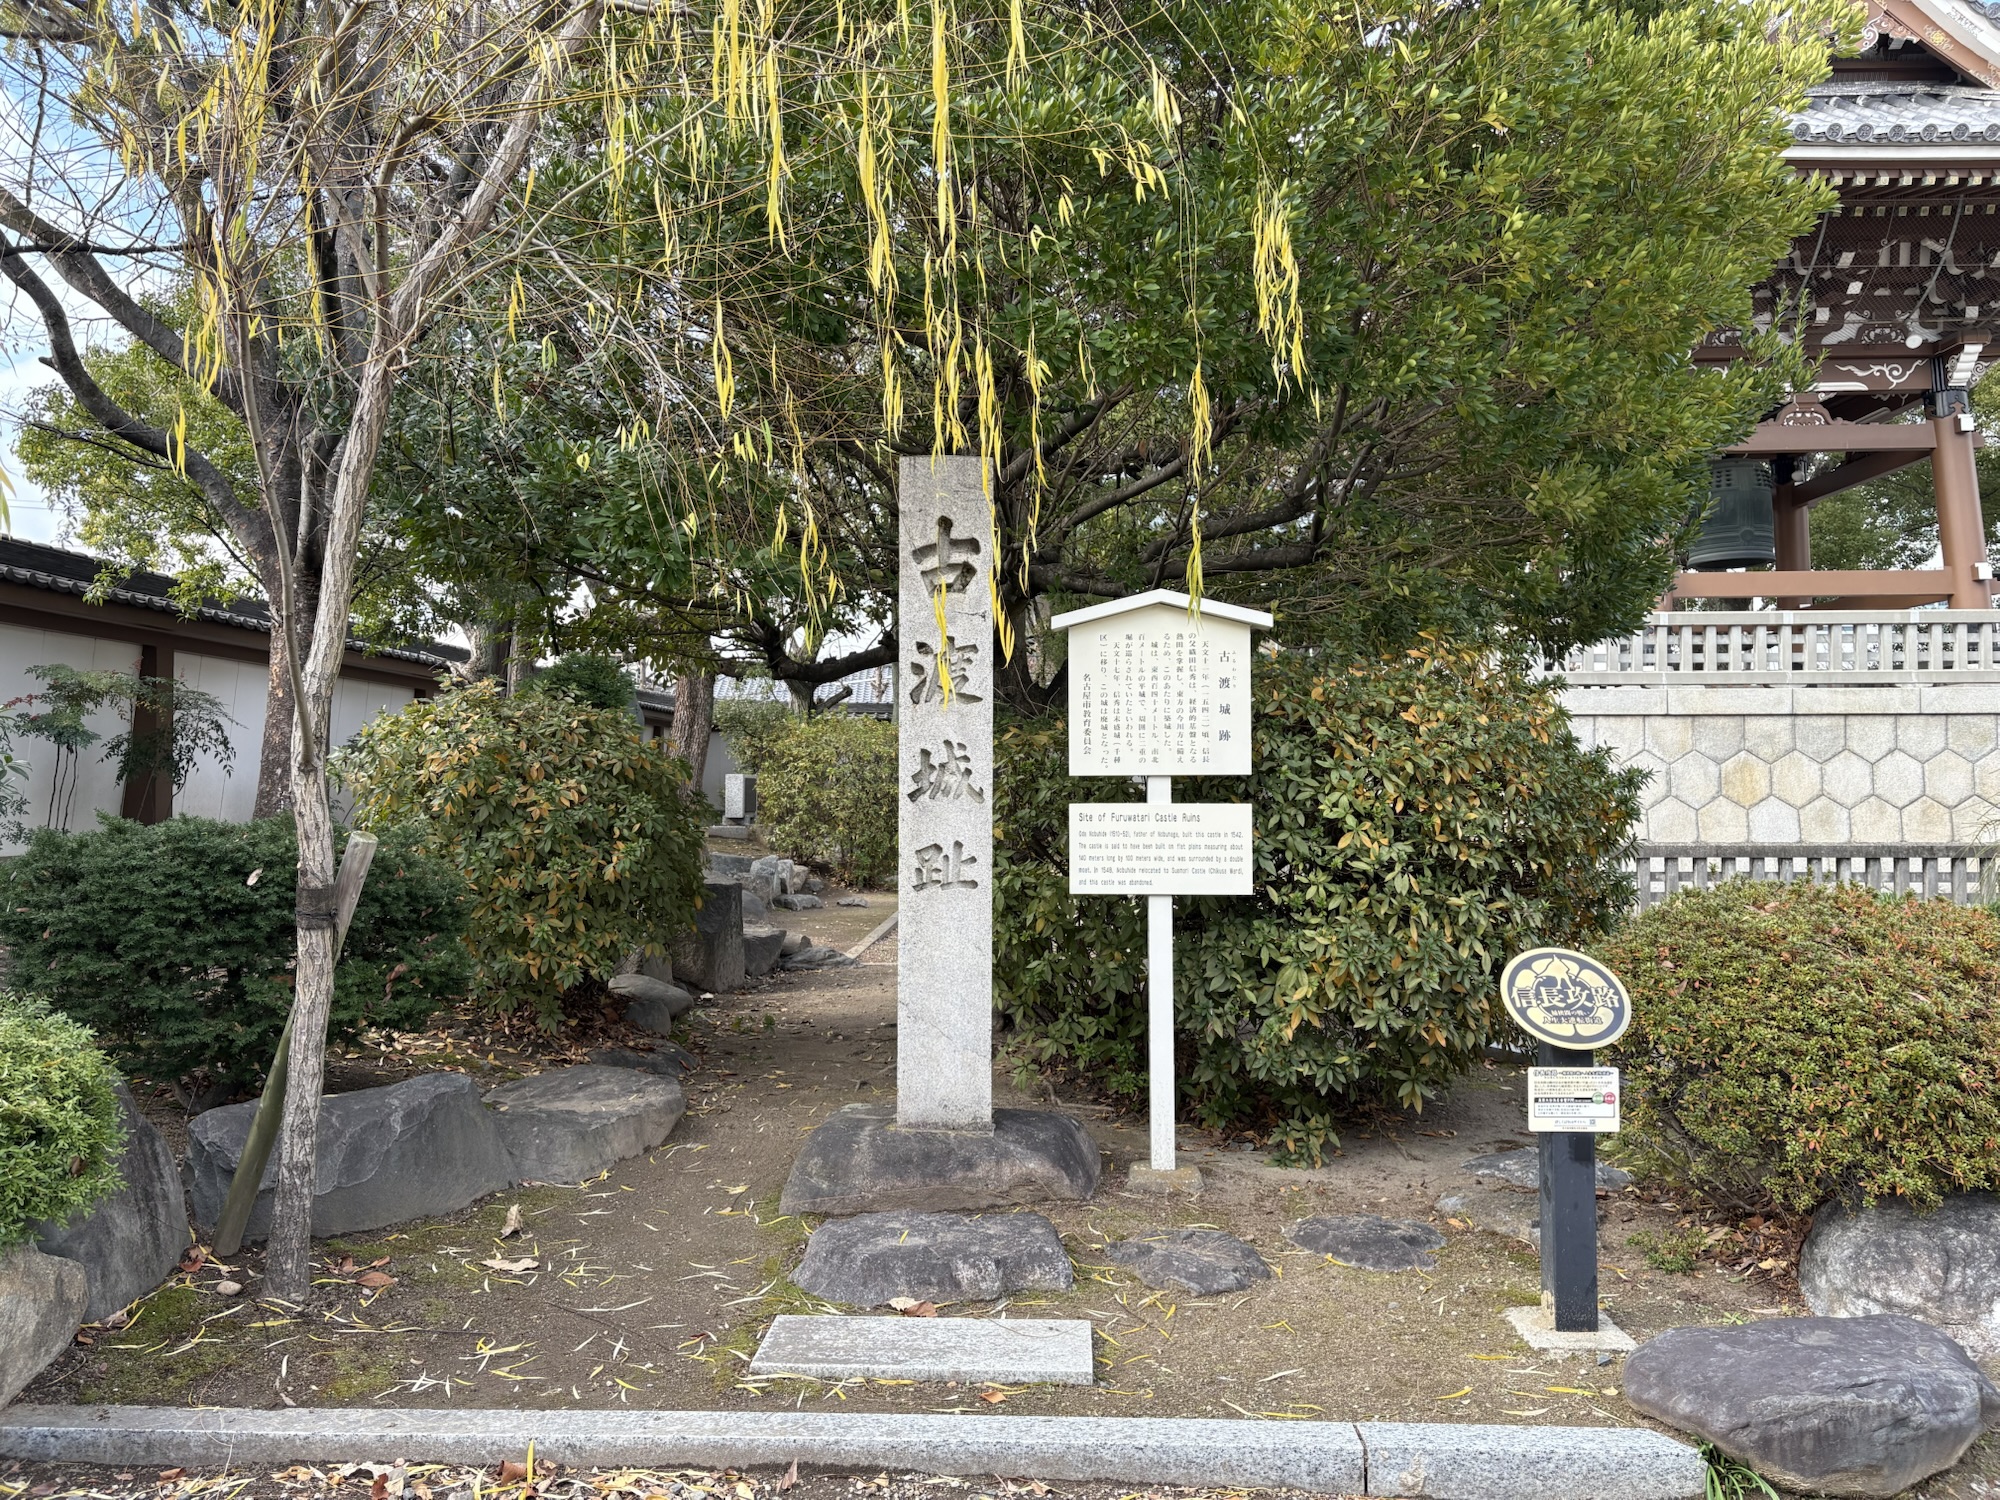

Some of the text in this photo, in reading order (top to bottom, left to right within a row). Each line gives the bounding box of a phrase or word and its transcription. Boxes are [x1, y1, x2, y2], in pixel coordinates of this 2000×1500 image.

[1218, 650, 1232, 742] 古渡城跡
[1082, 673, 1092, 755] 名古屋市教育委員会
[1079, 813, 1200, 823] Site of Furuwatari Castle Ruins
[1189, 843, 1201, 852] plains
[1204, 843, 1227, 852] measuring
[1107, 855, 1115, 863] long
[1154, 855, 1164, 863] wide,
[1511, 986, 1619, 1009] 信長攻路
